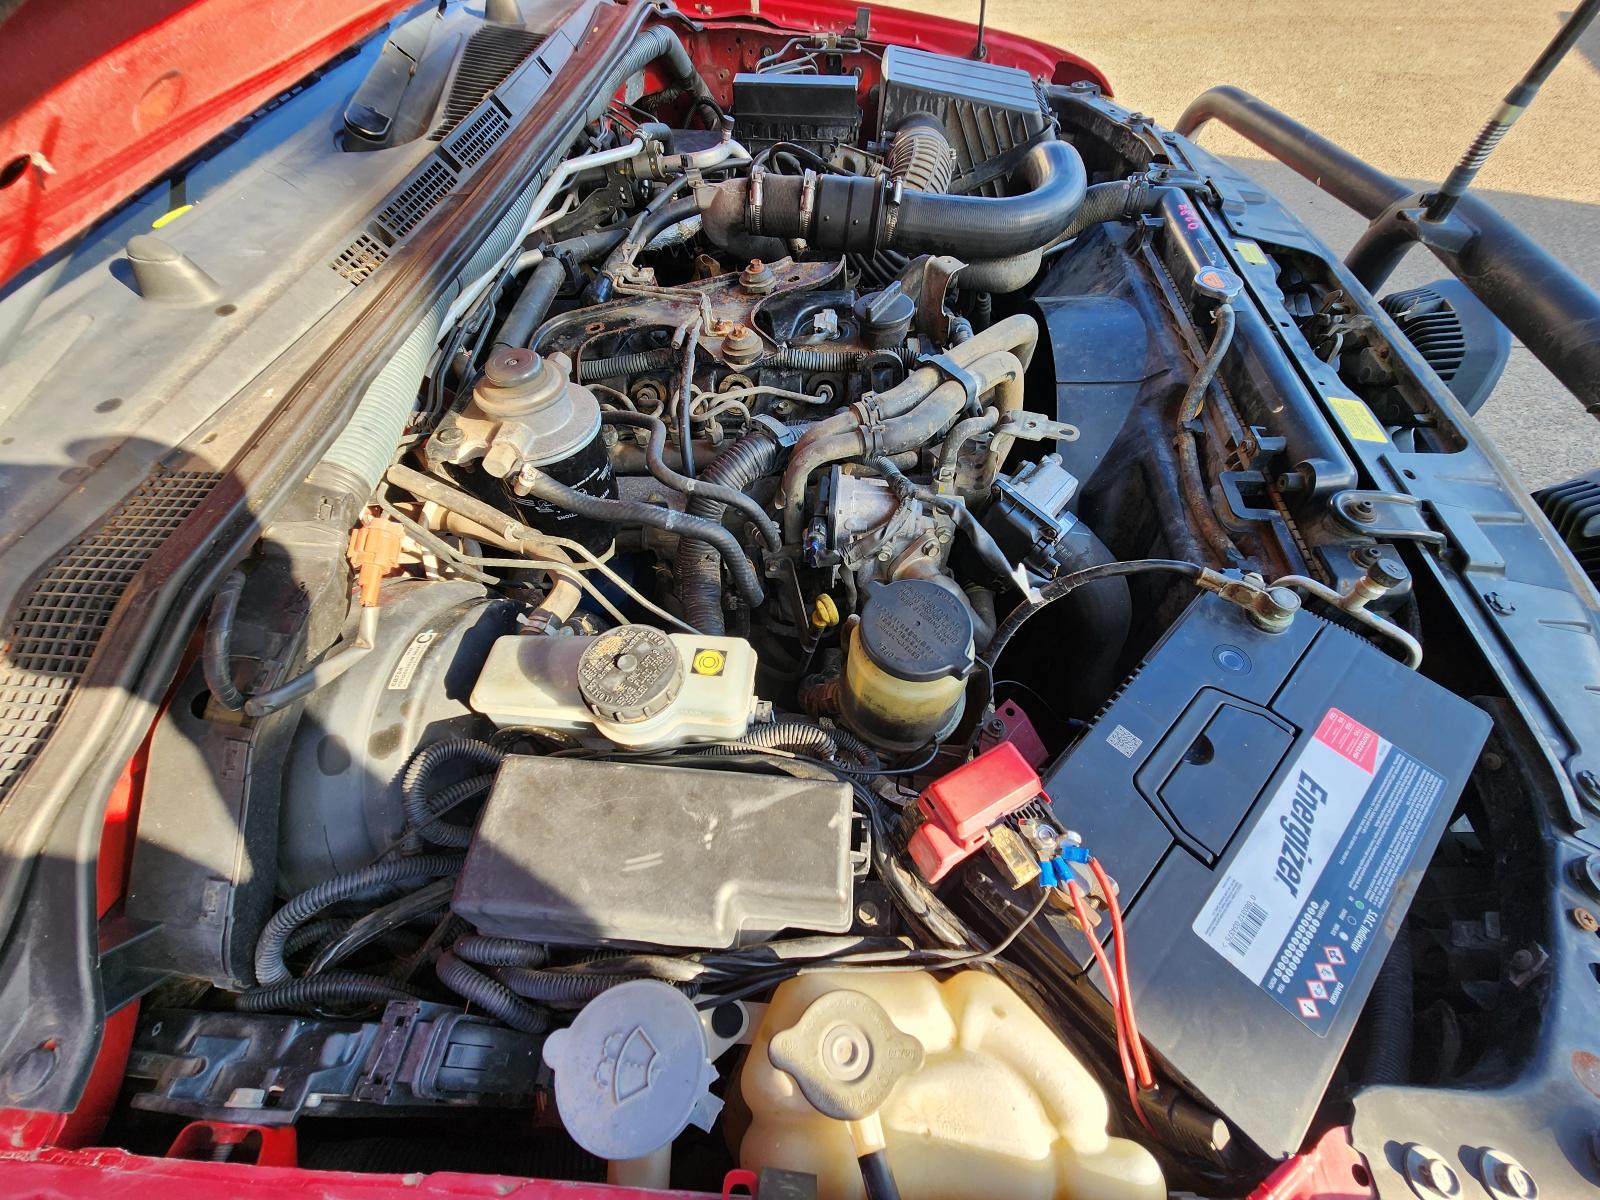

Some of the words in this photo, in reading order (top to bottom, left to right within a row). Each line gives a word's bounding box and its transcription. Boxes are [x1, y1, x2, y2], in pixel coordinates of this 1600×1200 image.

[1276, 769, 1328, 900] Energizer
[1352, 924, 1370, 953] Indicator
[1329, 982, 1344, 1005] DANGER
